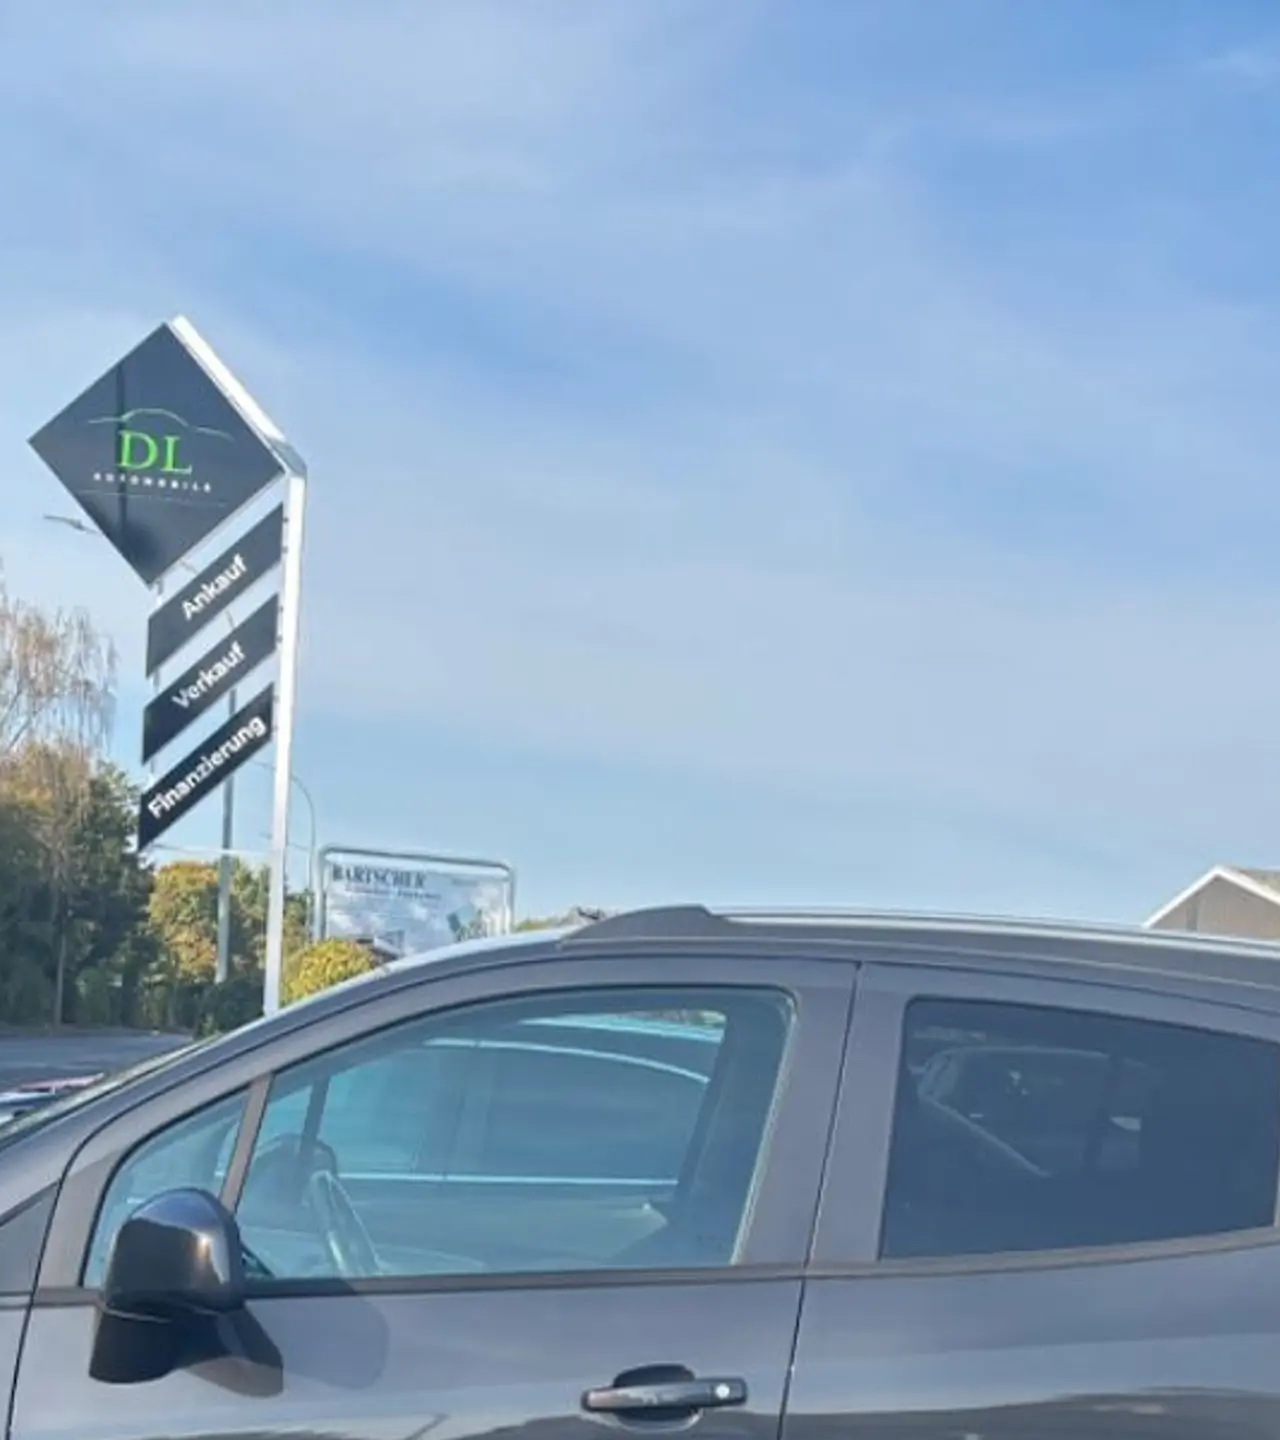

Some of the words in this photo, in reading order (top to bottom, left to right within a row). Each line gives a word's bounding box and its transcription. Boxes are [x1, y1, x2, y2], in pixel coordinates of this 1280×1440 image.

[117, 430, 193, 475] DL
[180, 552, 248, 620] Ankauf
[172, 640, 247, 709] Verkauf
[147, 715, 267, 819] Finanzierung
